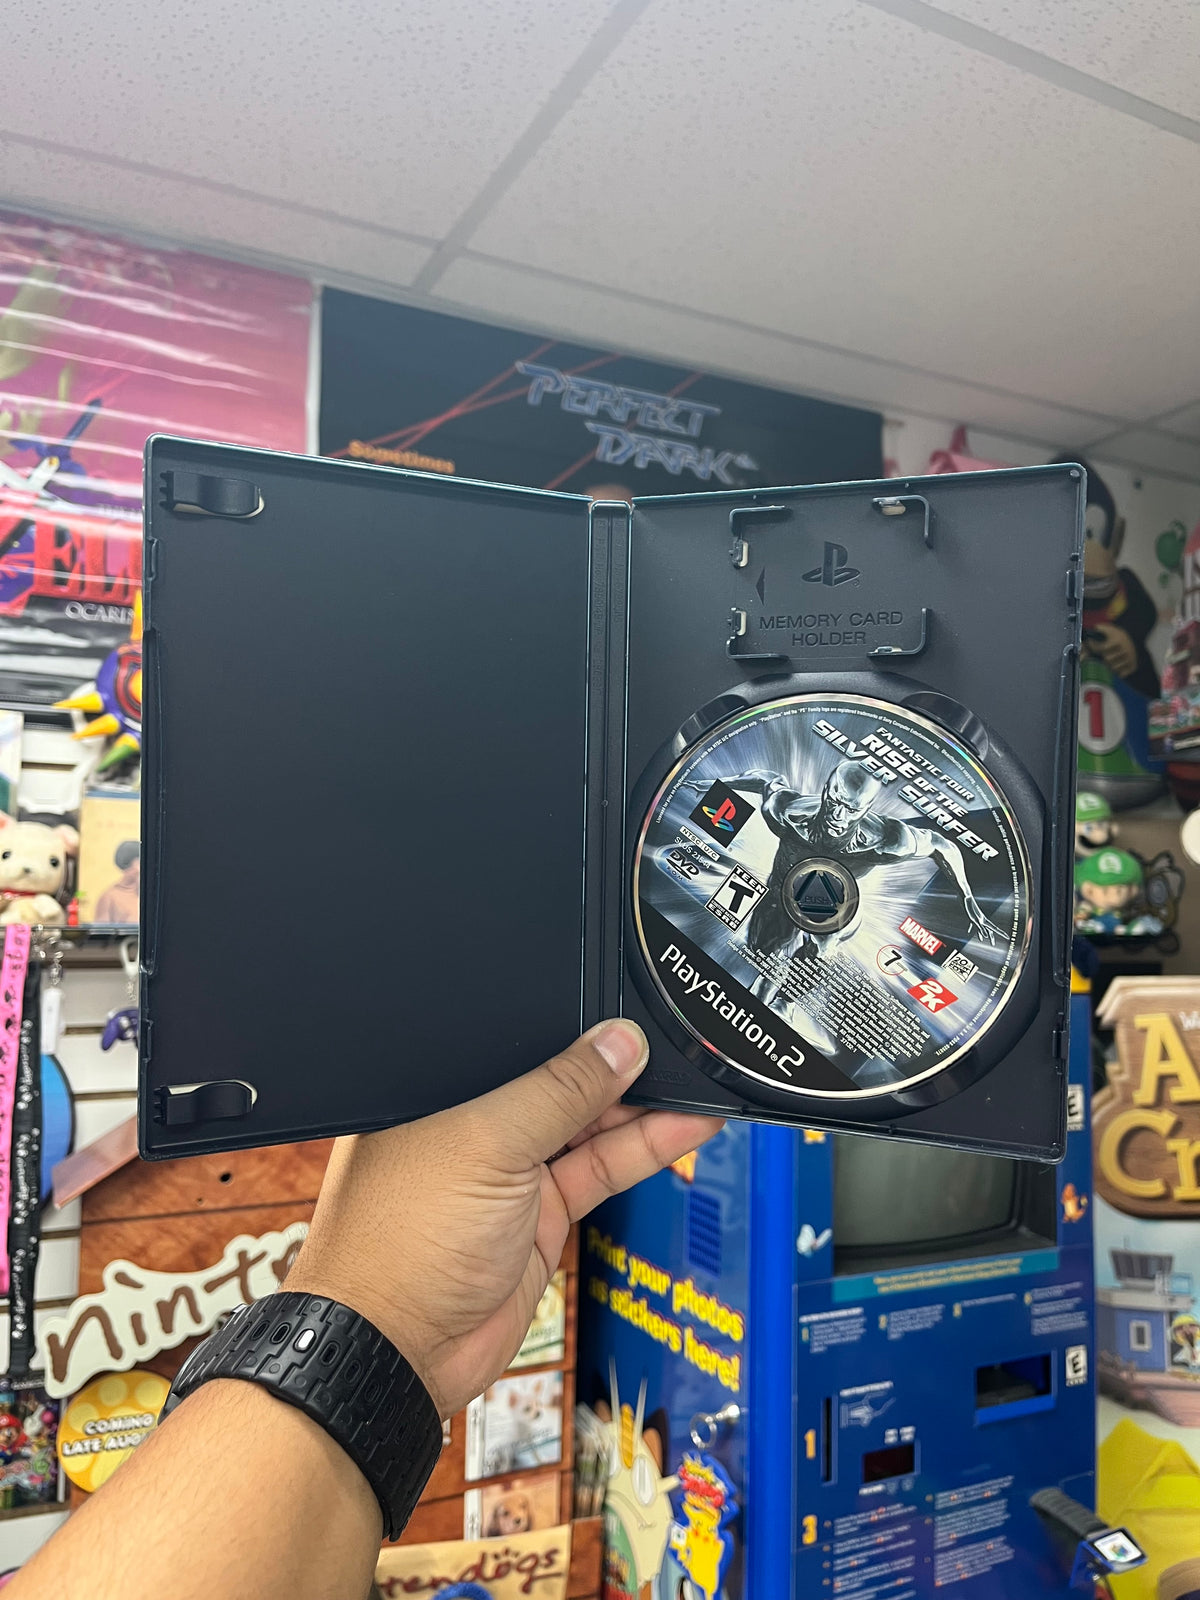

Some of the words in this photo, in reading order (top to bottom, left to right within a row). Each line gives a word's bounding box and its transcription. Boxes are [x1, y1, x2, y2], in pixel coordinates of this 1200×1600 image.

[515, 361, 722, 437] PERFECT
[585, 421, 758, 486] DARK
[759, 612, 843, 630] MEMORY
[849, 611, 903, 627] CARD
[791, 631, 867, 647] HOLDER
[1083, 691, 1105, 738] 1
[860, 734, 922, 779] RISE
[913, 777, 938, 798] OF
[934, 792, 968, 818] THE
[876, 727, 942, 776] FANTASTIC
[939, 775, 975, 801] FOUR
[812, 719, 898, 785] SILVER
[898, 784, 999, 862] SURFER
[669, 850, 701, 876] DVD
[733, 866, 766, 894] TEEN
[728, 880, 755, 914] T
[706, 902, 739, 929] ESRB
[899, 917, 941, 954] MARVEL
[884, 949, 903, 967] 7
[918, 980, 946, 1012] 2K
[1132, 1012, 1200, 1106] A
[627, 1252, 672, 1297] your
[671, 1275, 745, 1343] photos
[608, 1286, 683, 1353] stickers
[683, 1324, 742, 1394] here!
[1071, 1353, 1083, 1375] E
[84, 1413, 155, 1436] COMING
[62, 1438, 103, 1457] LATE
[804, 1428, 816, 1460] 1
[801, 1513, 818, 1546] 3
